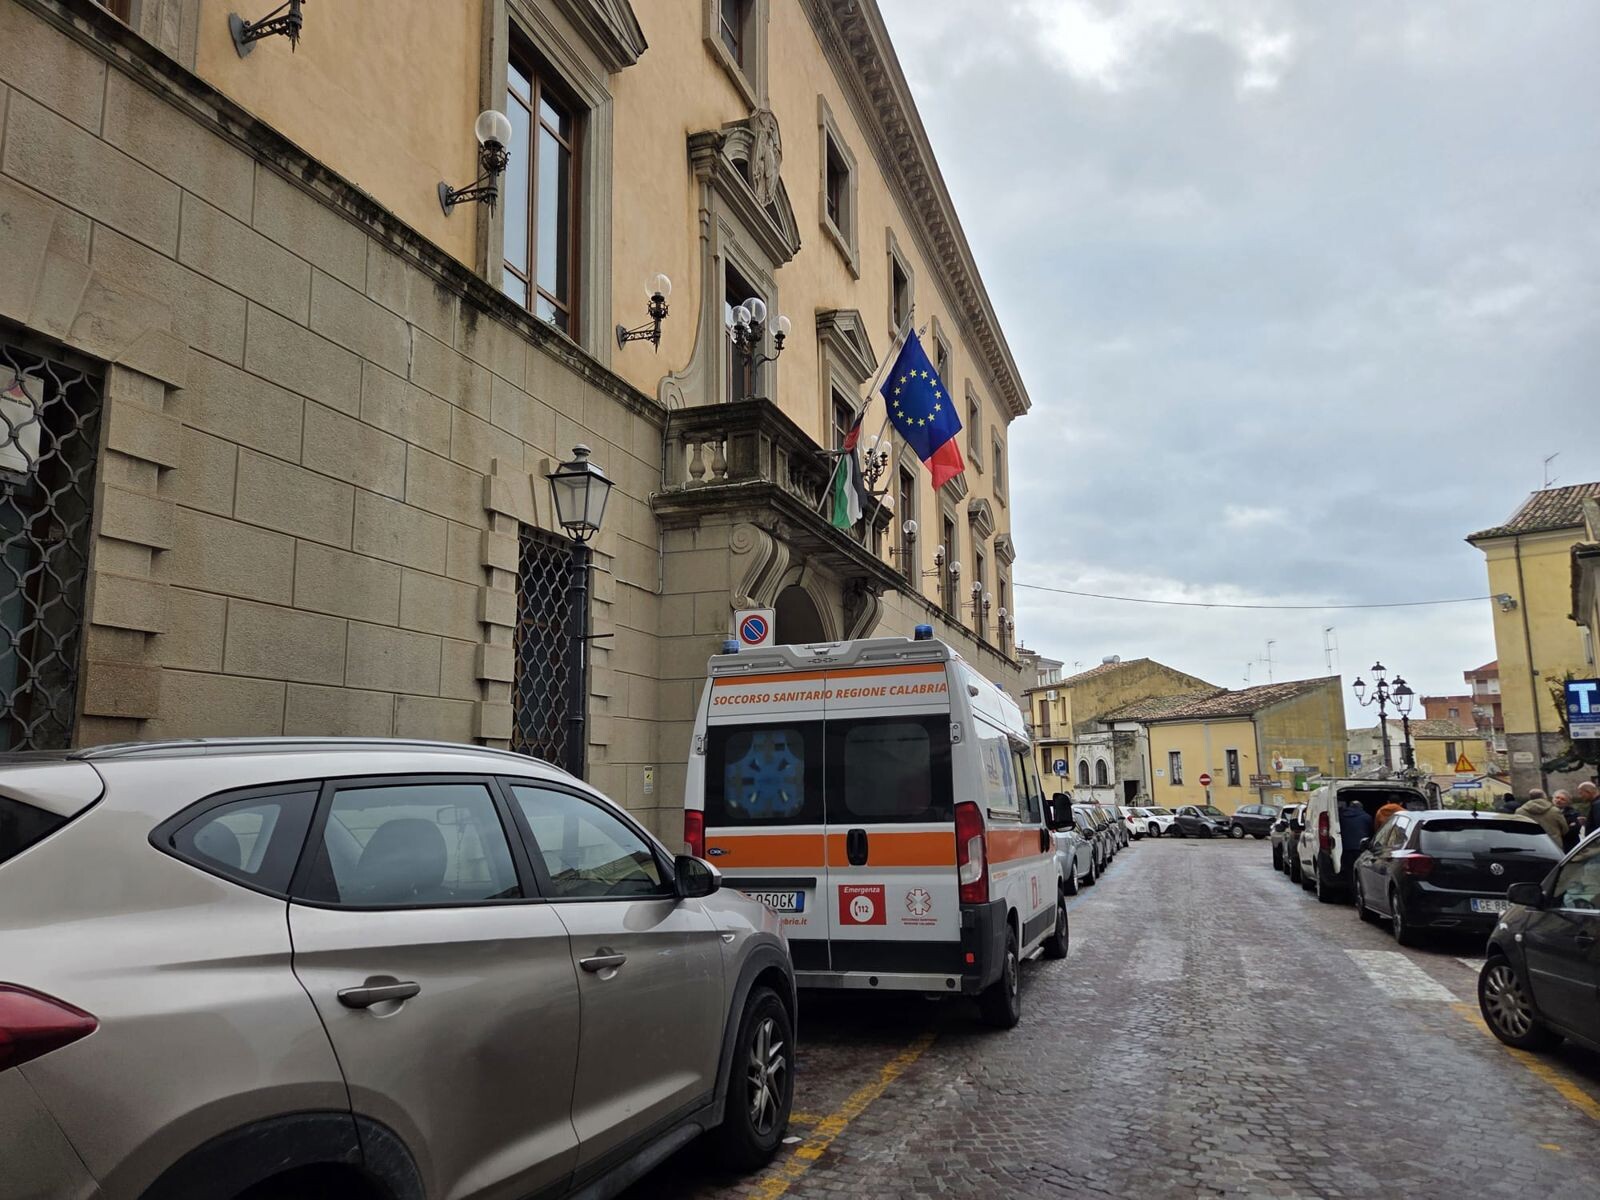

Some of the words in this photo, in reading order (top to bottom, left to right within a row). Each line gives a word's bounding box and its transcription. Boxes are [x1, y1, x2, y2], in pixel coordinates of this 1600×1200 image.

[713, 693, 770, 706] SOCCORSO
[772, 690, 833, 703] SANITARIO
[835, 686, 888, 699] REGIONE
[889, 682, 948, 696] CALABRIA
[1057, 760, 1065, 770] P
[1350, 755, 1359, 765] P
[843, 886, 881, 895] Emergenza
[857, 905, 869, 913] 112
